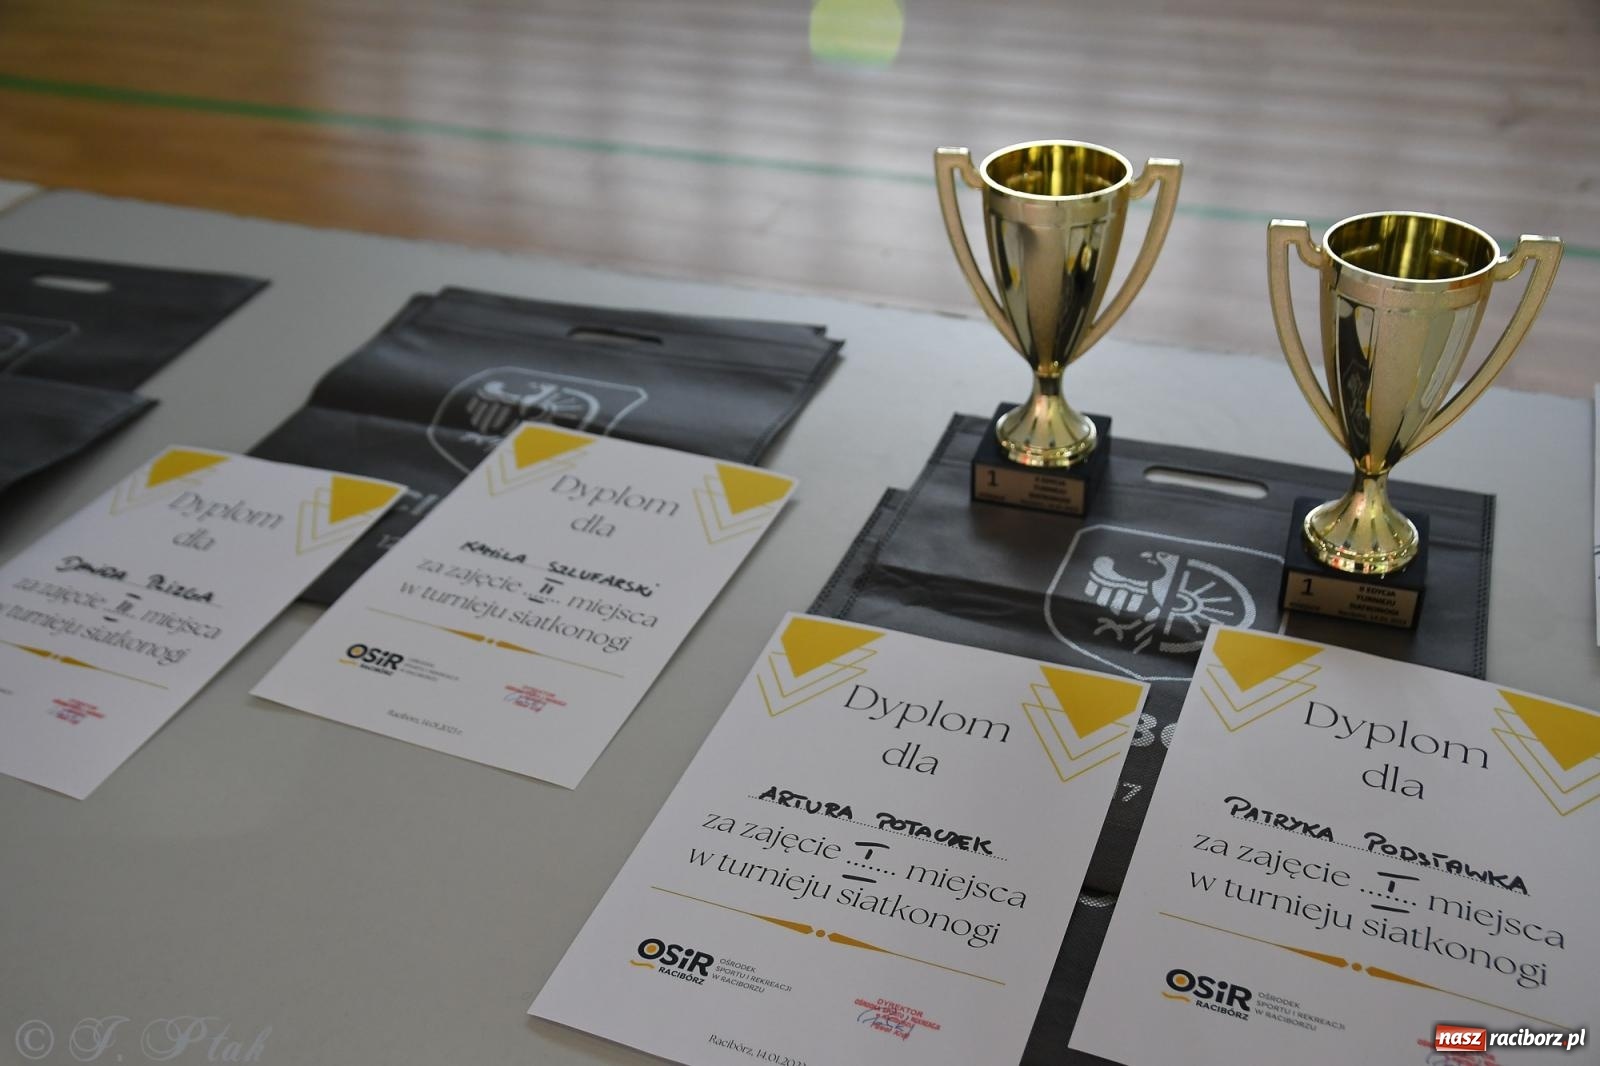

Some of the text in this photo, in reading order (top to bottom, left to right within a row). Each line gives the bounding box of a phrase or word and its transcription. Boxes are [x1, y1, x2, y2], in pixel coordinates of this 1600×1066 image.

[549, 473, 681, 518] Dyplom
[987, 470, 998, 487] 1
[168, 490, 285, 532] Dyplom
[569, 511, 617, 540] dla
[172, 526, 217, 553] dla
[417, 556, 447, 575] za
[443, 565, 523, 594] zajęcie
[567, 594, 659, 629] miejsca
[1301, 578, 1314, 596] 1
[40, 581, 107, 610] zajęcie
[139, 608, 222, 640] miejsca
[399, 580, 632, 654] w turnieju siatkonogi
[80, 625, 192, 666] siatkonogi
[843, 684, 1011, 743] Dyplom
[1304, 700, 1491, 770] Dyplom
[882, 742, 939, 776] dla
[1361, 764, 1425, 801] dla
[758, 786, 854, 821] ARTURA
[702, 813, 735, 834] za
[739, 821, 842, 861] zajęcie
[905, 862, 1027, 910] miejsca
[1224, 795, 1530, 896] PATRYKA PODSTAWKA
[689, 848, 1001, 949] w turnieju siatkonogi
[1193, 833, 1229, 857] za
[1236, 843, 1351, 889] zajęcie
[1428, 892, 1565, 950] miejsca
[1189, 870, 1548, 990] w turnieju siatkonogi
[658, 966, 705, 986] RACIBÓRZ
[715, 965, 746, 980] SPORTU
[750, 975, 793, 993] REKREACJI
[719, 957, 757, 974] OŚRODEK
[721, 976, 765, 994] RACIBORZU
[1258, 992, 1301, 1009] OŚRODEK
[877, 998, 924, 1018] DYREKTOR
[1195, 1000, 1249, 1021] RACIBÓRZ
[1256, 1000, 1292, 1016] SPORTU
[1297, 1011, 1346, 1031] REKREACJI
[1265, 1011, 1317, 1032] RACIBORZU
[708, 1034, 754, 1057] Racibórz,
